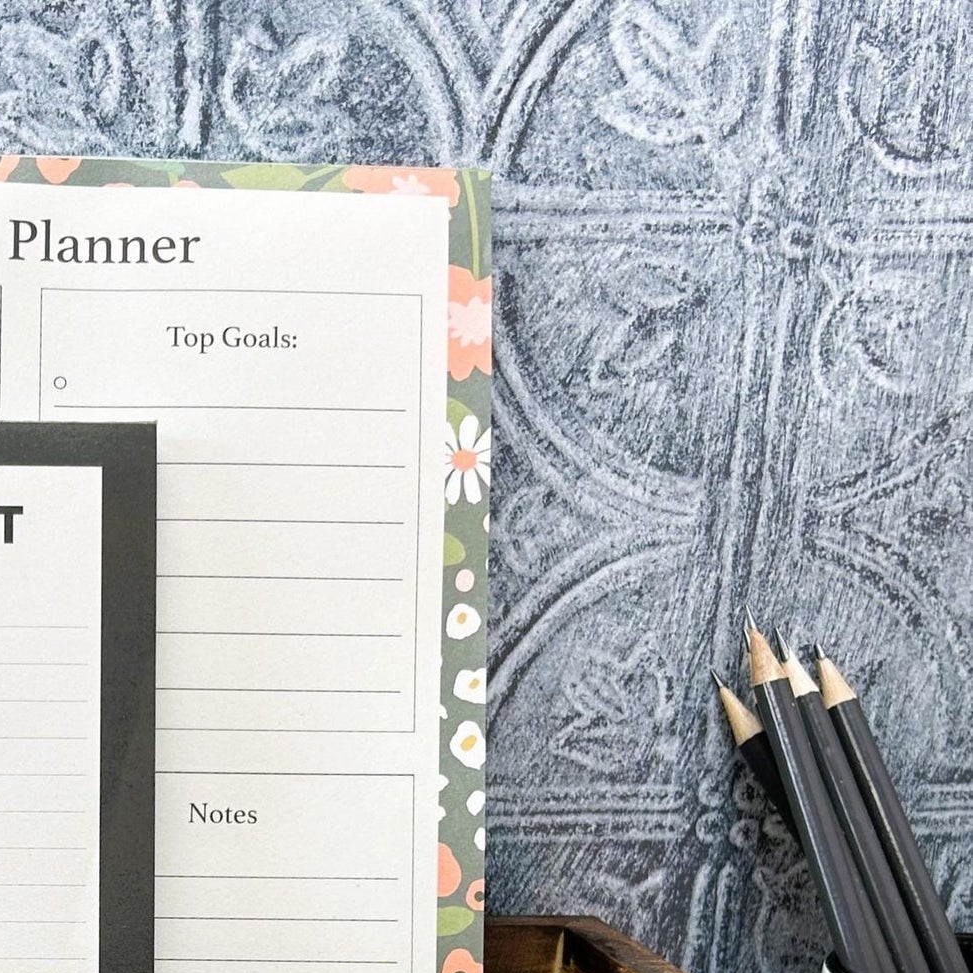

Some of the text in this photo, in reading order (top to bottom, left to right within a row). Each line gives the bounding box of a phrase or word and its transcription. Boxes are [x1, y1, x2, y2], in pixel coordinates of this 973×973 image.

[10, 220, 200, 263] Planner
[167, 327, 296, 353] Top Goals:
[190, 803, 257, 823] Notes
